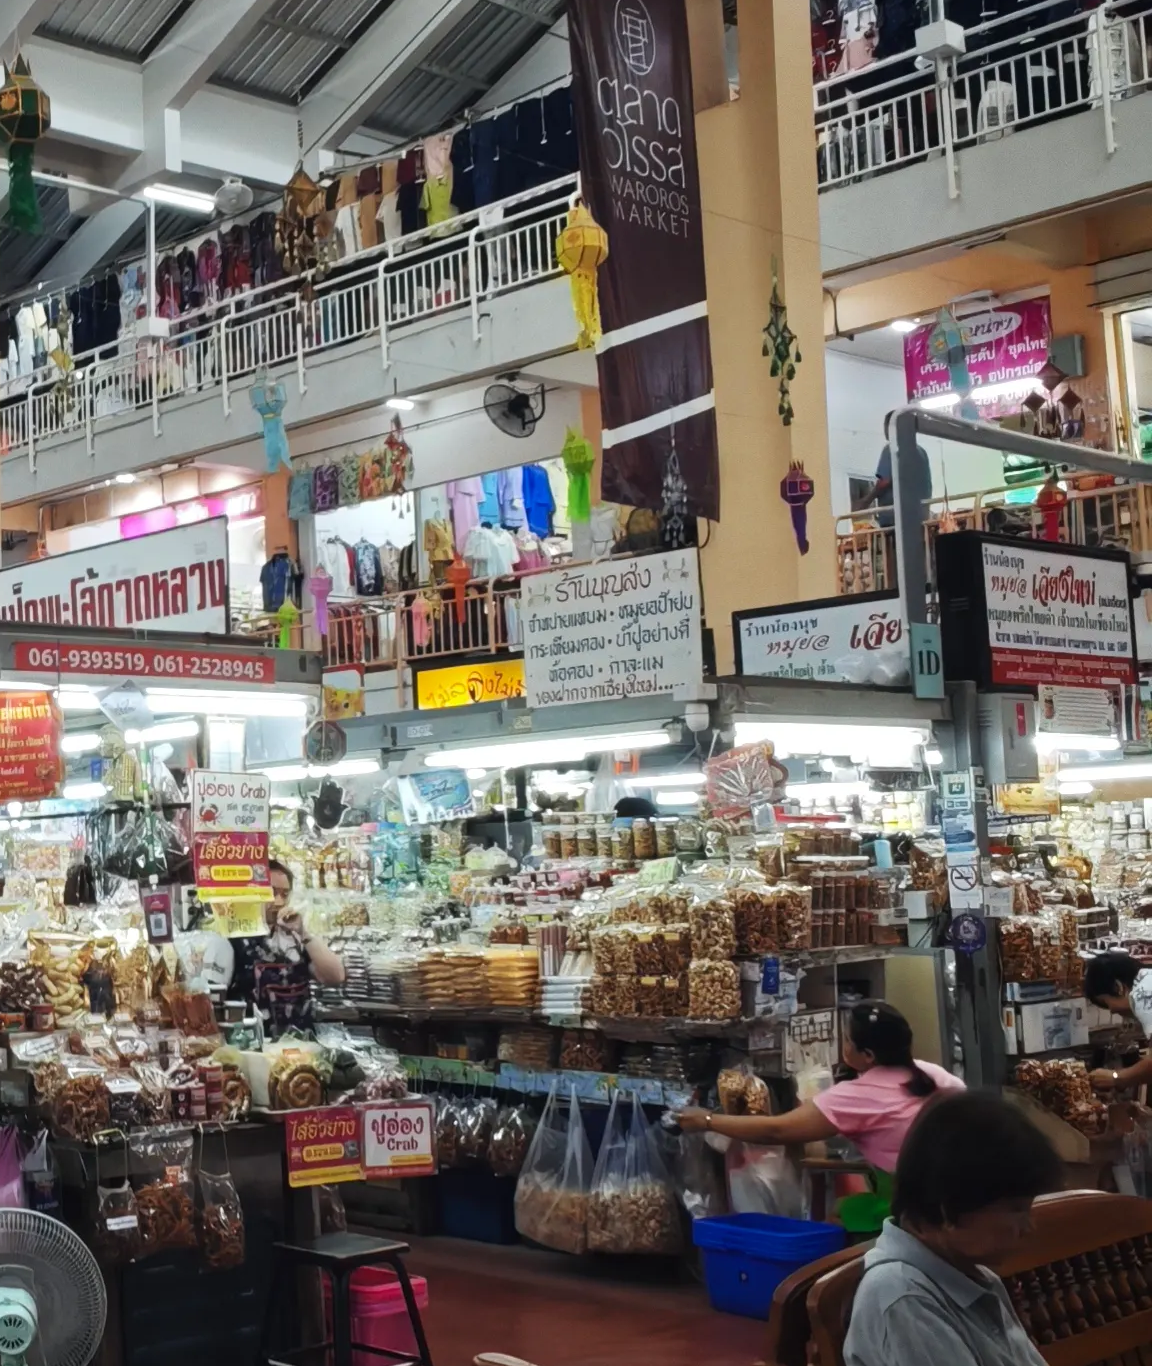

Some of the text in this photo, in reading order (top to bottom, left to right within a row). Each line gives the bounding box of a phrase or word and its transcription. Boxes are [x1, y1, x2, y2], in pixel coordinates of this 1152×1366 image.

[598, 77, 681, 137] ตลาด
[603, 120, 686, 188] วโรรส
[610, 175, 688, 215] WAROROS
[613, 198, 689, 238] MARKET
[555, 563, 651, 603] ร้านบุญส่ง
[745, 617, 818, 636] ร้านน้องนุช
[767, 634, 830, 659] หมูยอ
[28, 648, 264, 680] 061-9393519, 061-2528945
[241, 782, 266, 798] Crab
[372, 1112, 424, 1145] ปูอ่อง
[387, 1136, 419, 1151] Crab
